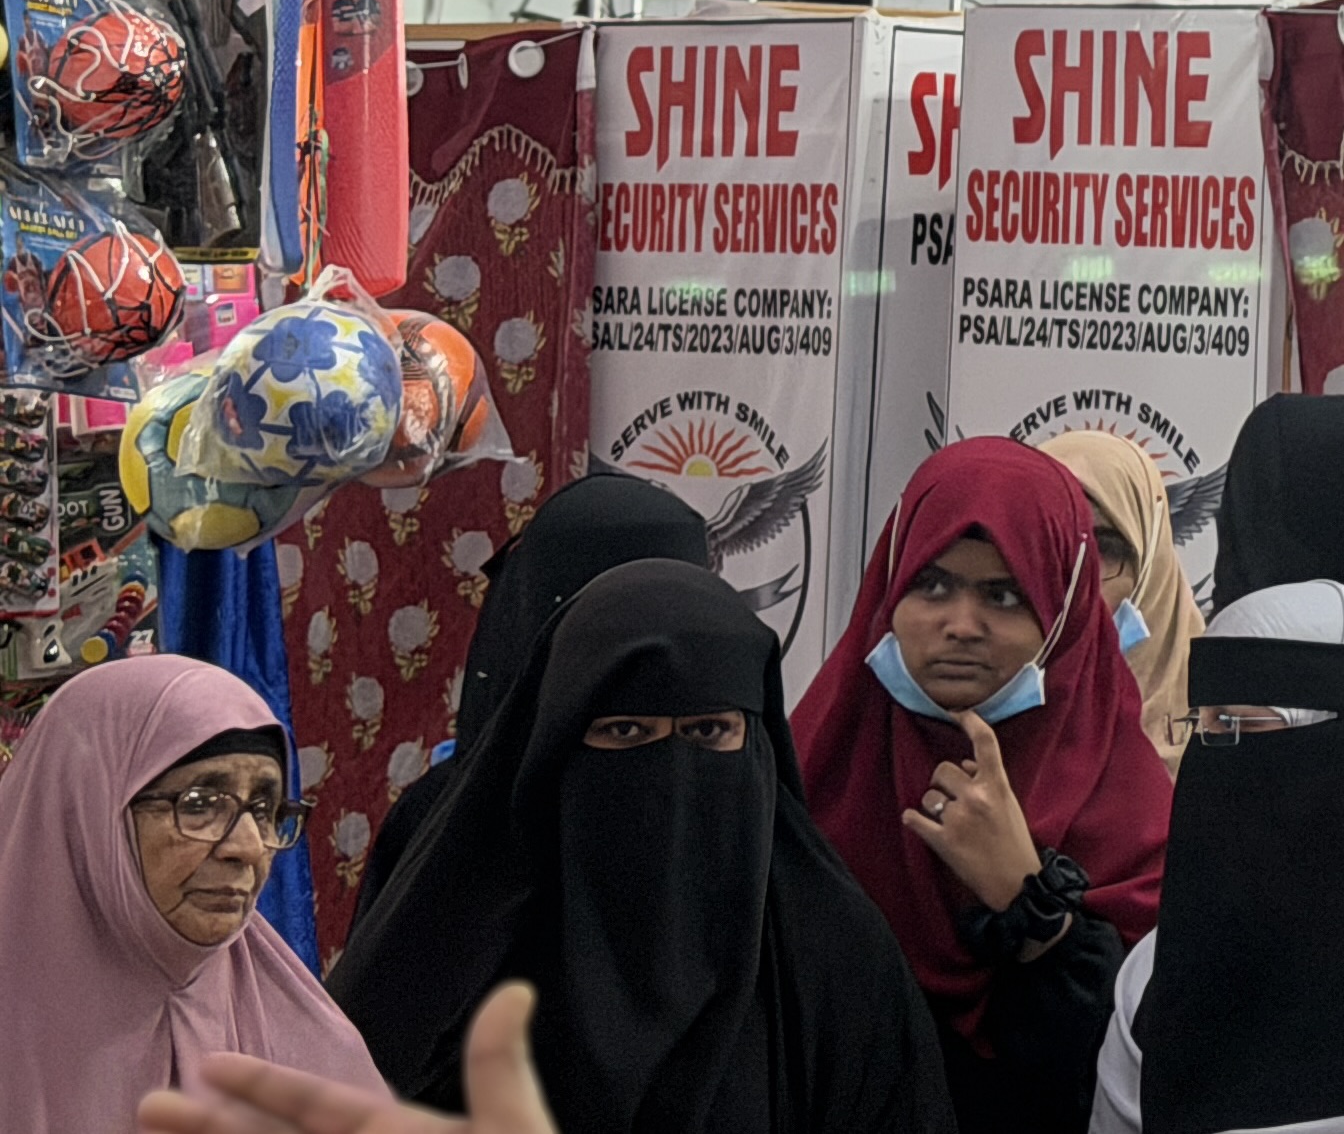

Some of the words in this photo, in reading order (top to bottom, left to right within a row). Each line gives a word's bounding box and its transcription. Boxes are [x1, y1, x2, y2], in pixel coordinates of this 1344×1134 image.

[625, 44, 801, 172] SHINE
[1012, 29, 1213, 161] SHINE
[713, 182, 839, 256] SERVICES
[965, 168, 1110, 246] SECURITY
[1114, 173, 1256, 251] SERVICES
[647, 286, 728, 318] LICENSE
[733, 287, 832, 321] COMPANY:
[958, 314, 1250, 357] PSA/L/24/TS/2023/AUG/3/409
[962, 277, 1033, 309] PSARA
[1040, 279, 1131, 313] LICENSE
[1137, 284, 1250, 319] COMPANY:
[610, 397, 673, 463] SERVE
[676, 390, 731, 415] WITH
[734, 402, 791, 470] SMILE
[1073, 389, 1132, 415] WITH
[1138, 403, 1201, 474] SMILE
[100, 488, 126, 532] GUN
